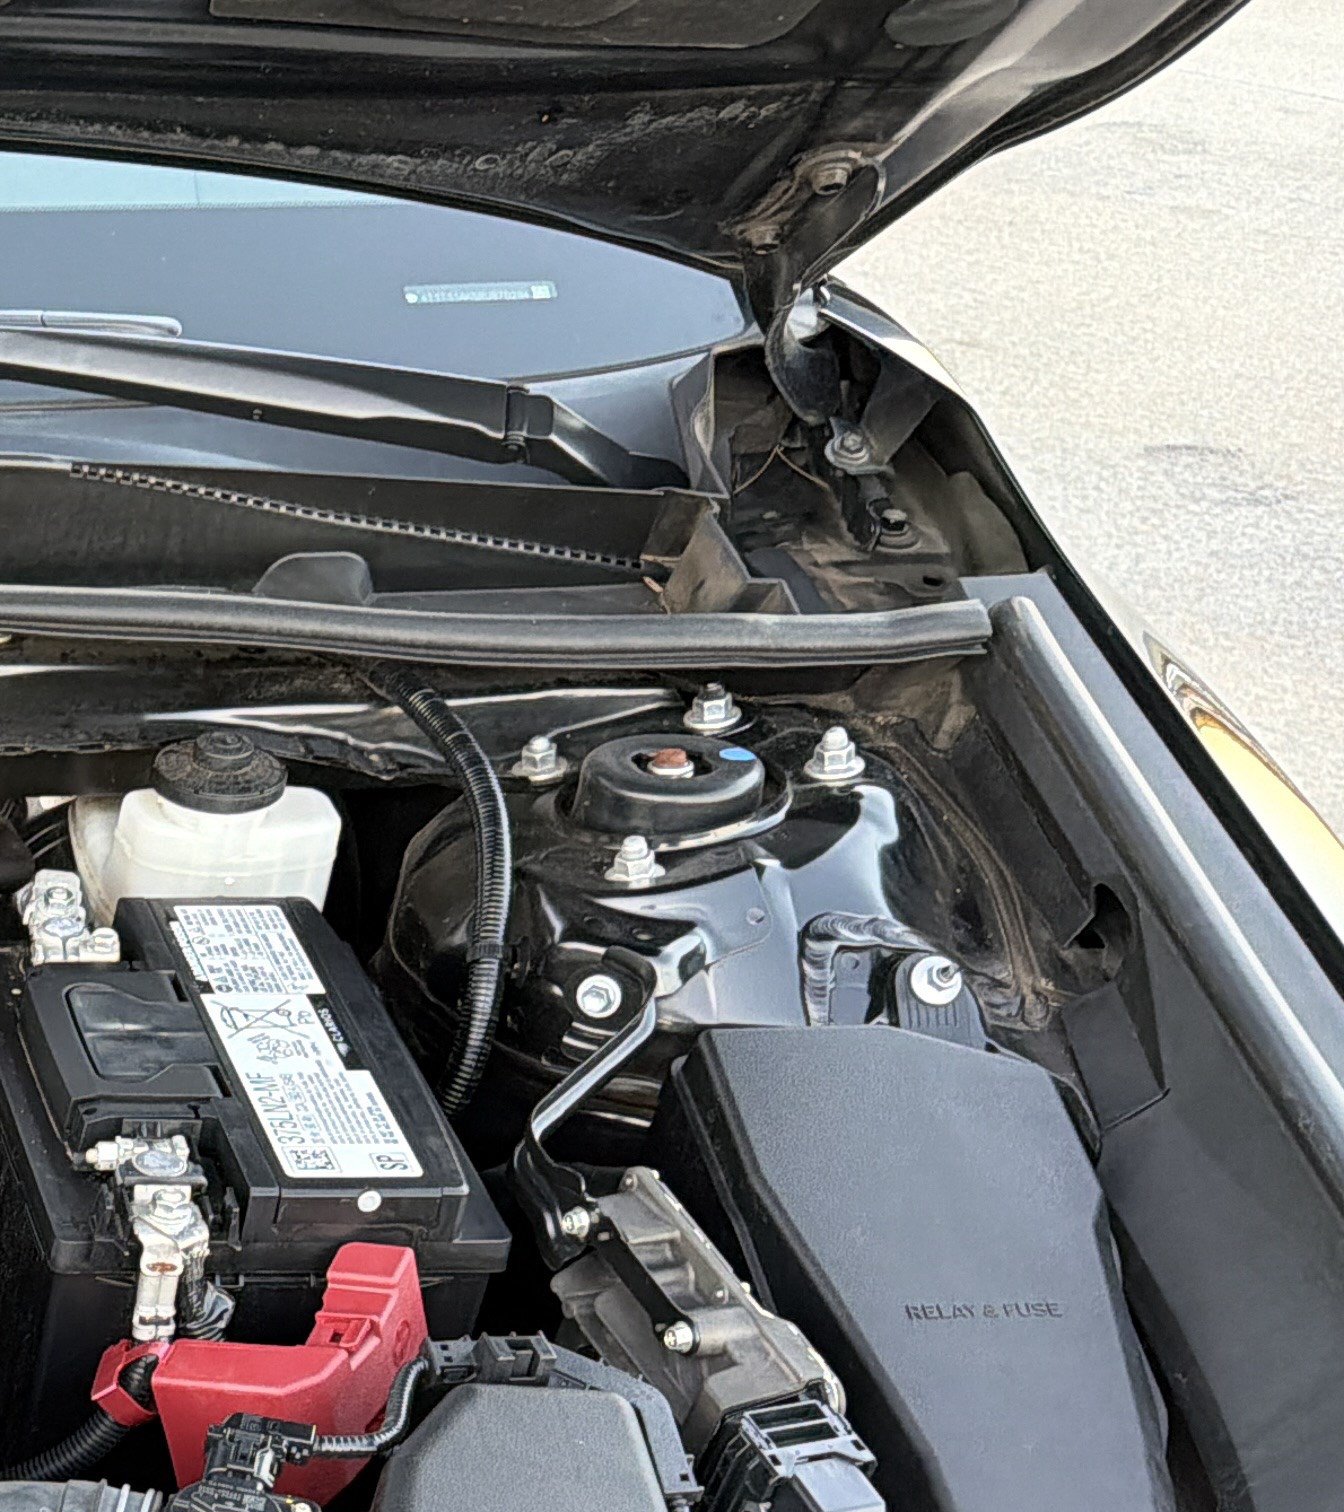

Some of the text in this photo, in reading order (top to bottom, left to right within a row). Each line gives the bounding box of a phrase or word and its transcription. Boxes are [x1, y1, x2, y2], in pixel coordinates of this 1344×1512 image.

[245, 1072, 306, 1144] 375LN2-MF
[376, 1154, 409, 1171] SP
[905, 1302, 1063, 1320] RELAY & FUSE
